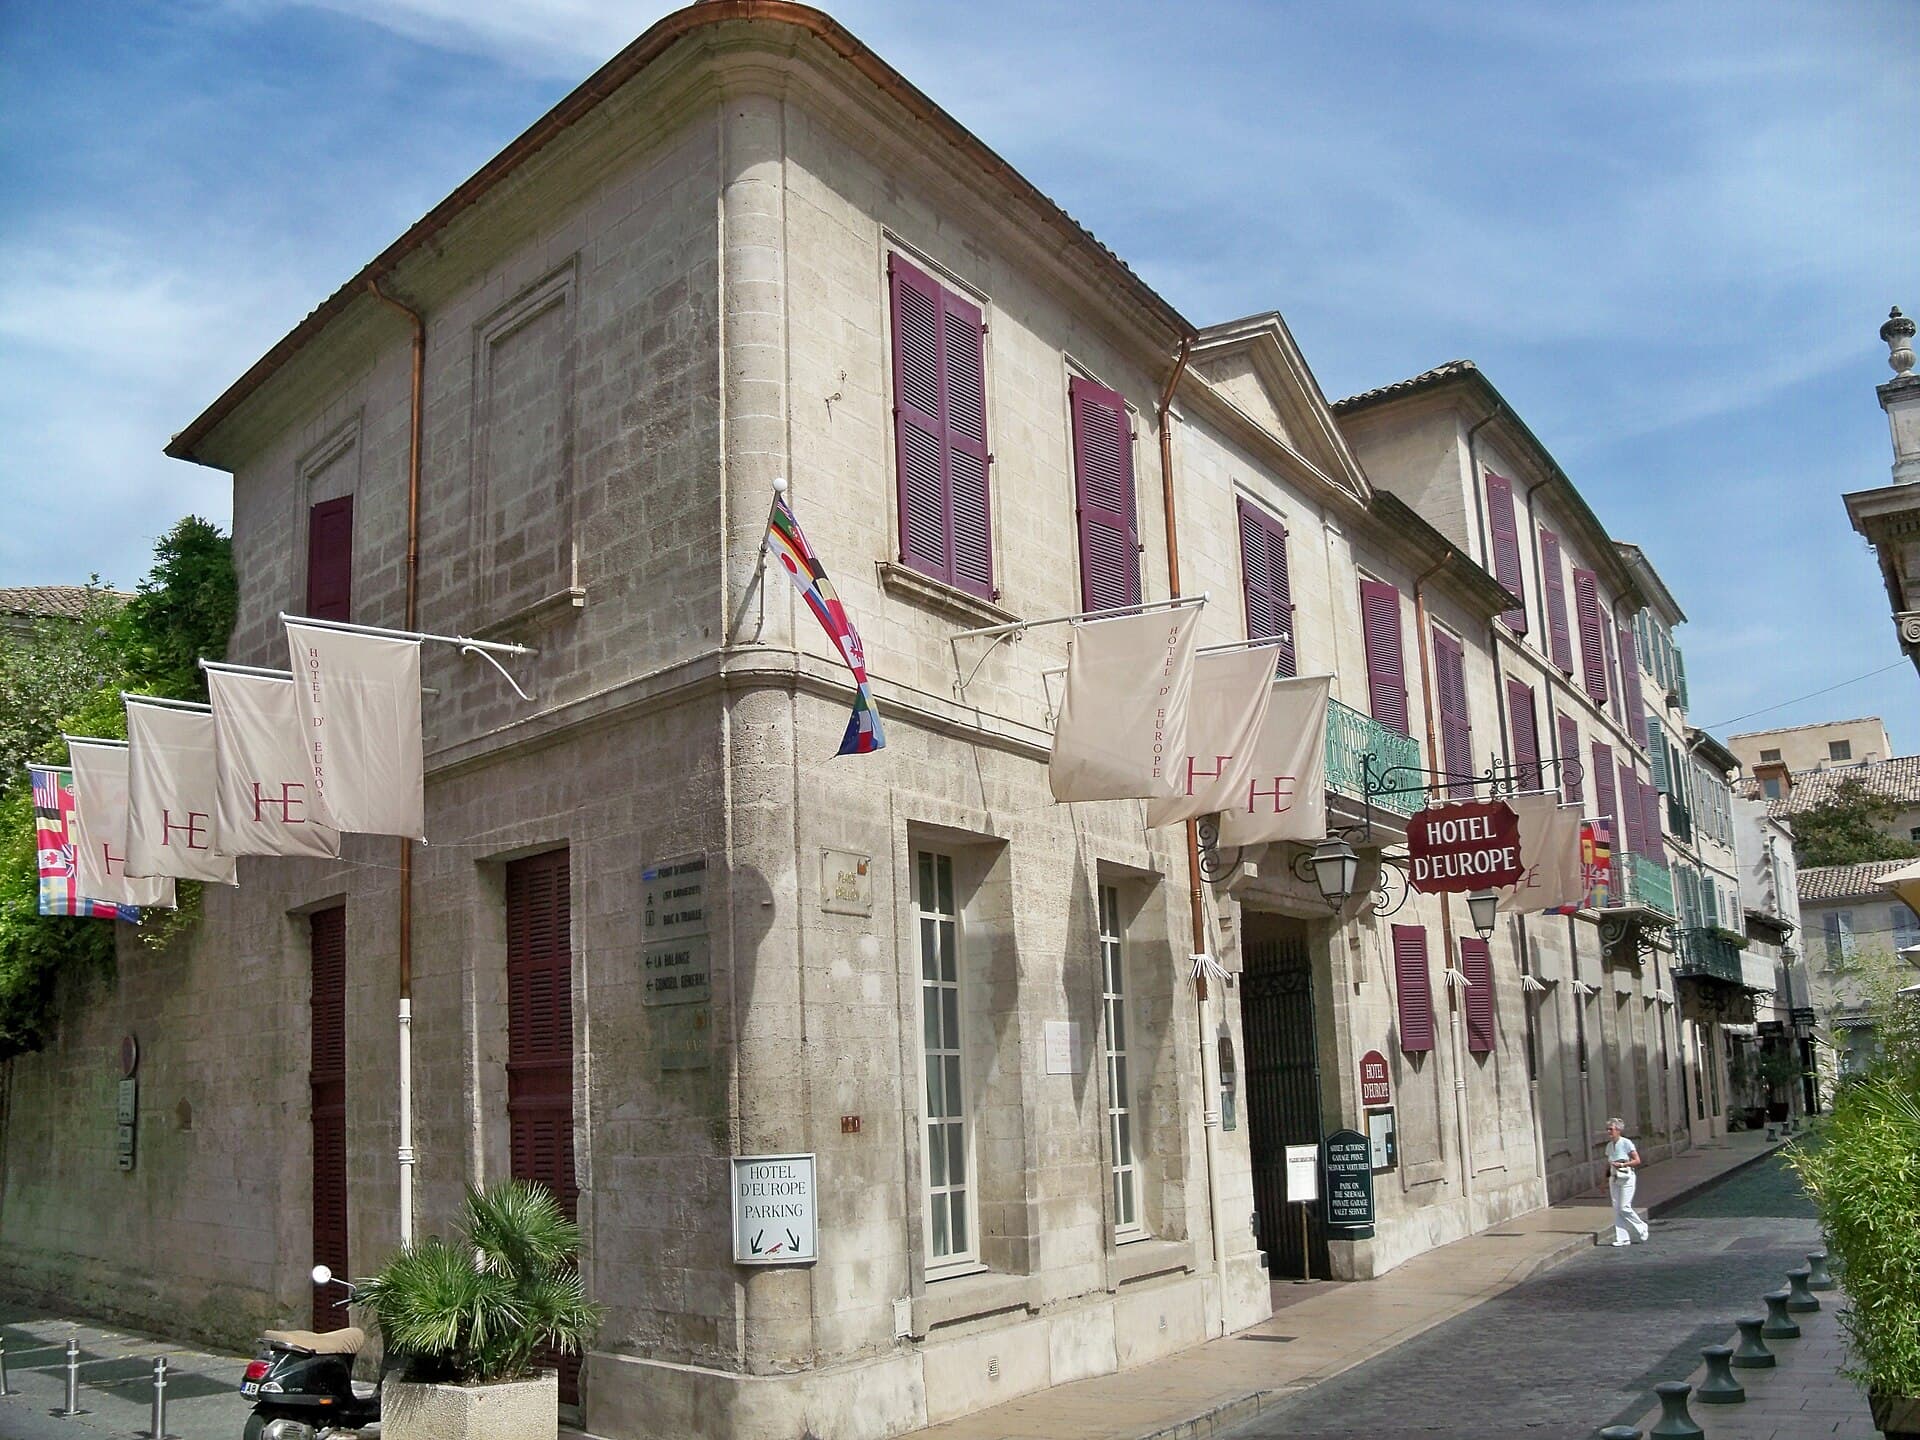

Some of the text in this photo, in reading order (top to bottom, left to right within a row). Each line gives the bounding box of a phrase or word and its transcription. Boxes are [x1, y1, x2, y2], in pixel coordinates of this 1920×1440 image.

[1163, 626, 1179, 677] HOTEL
[309, 647, 321, 703] HOTEL
[1152, 708, 1165, 778] EUROPE
[252, 782, 305, 823] HE
[1248, 776, 1297, 814] HE
[162, 809, 209, 850] HE
[1427, 816, 1497, 846] HOTEL
[1414, 846, 1516, 880] D'EUROPE
[1366, 1064, 1384, 1079] HOTEL
[741, 1181, 806, 1197] D'EUROPE
[749, 1165, 796, 1180] HOTEL
[744, 1202, 803, 1218] PARKING
